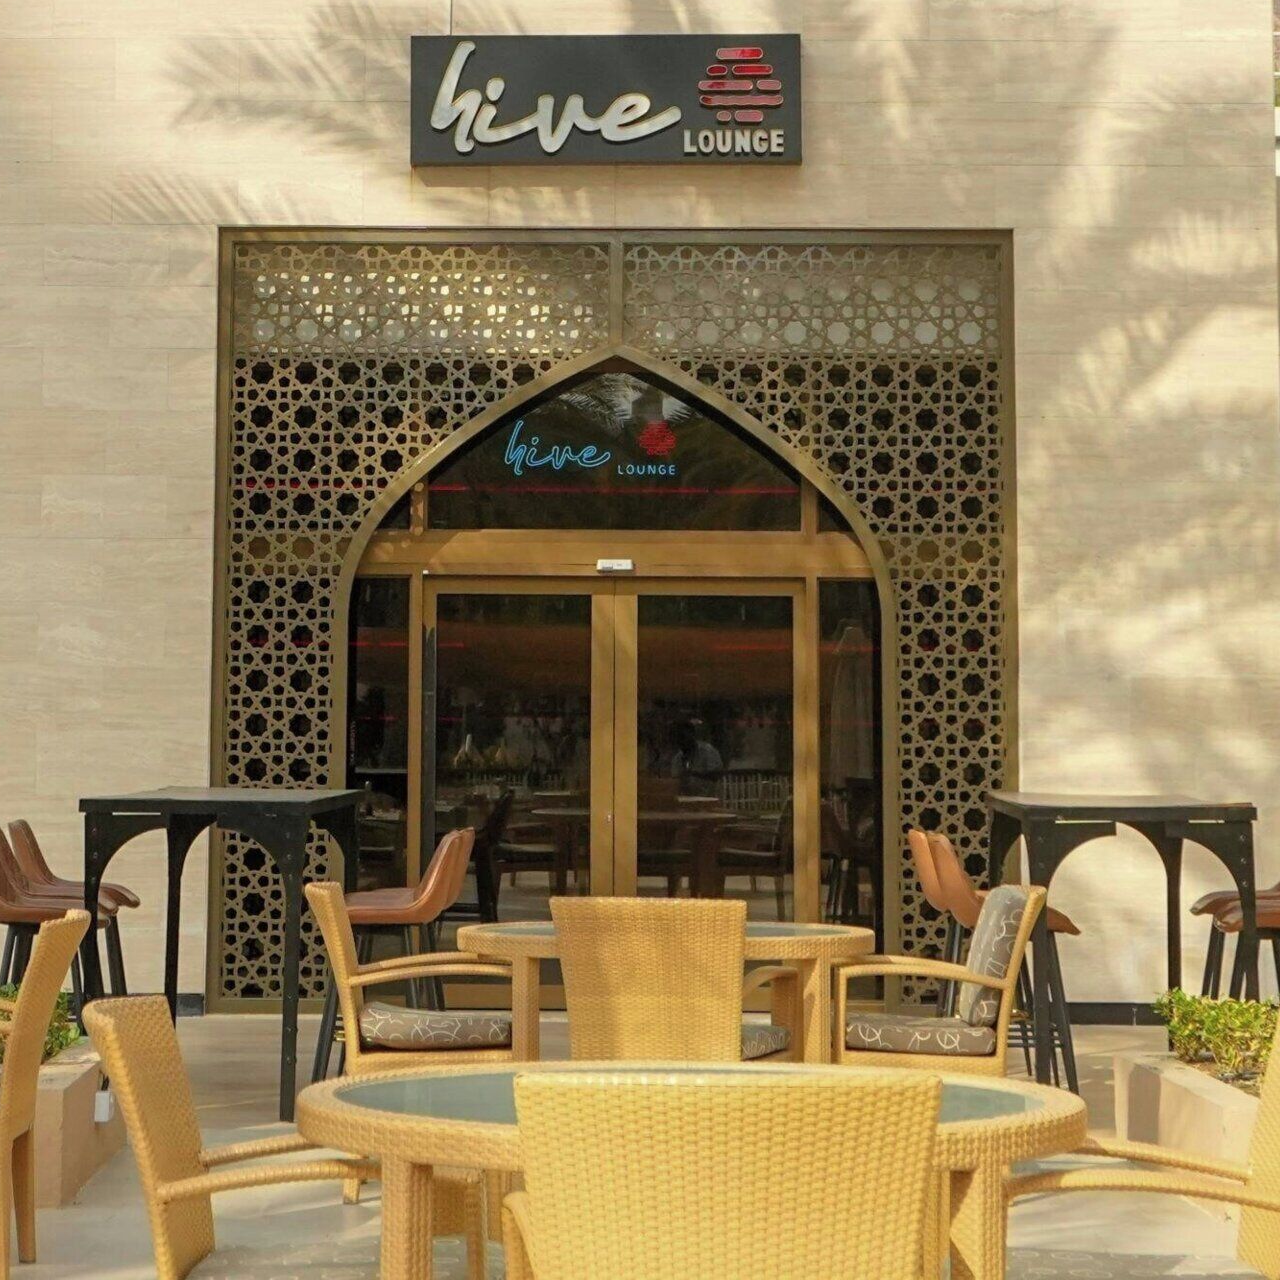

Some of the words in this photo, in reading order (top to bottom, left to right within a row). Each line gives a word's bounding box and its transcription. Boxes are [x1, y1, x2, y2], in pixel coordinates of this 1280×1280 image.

[431, 41, 682, 154] hive
[683, 129, 784, 153] LOUNGE
[505, 420, 610, 475] hive
[617, 464, 676, 475] LOUNGE
